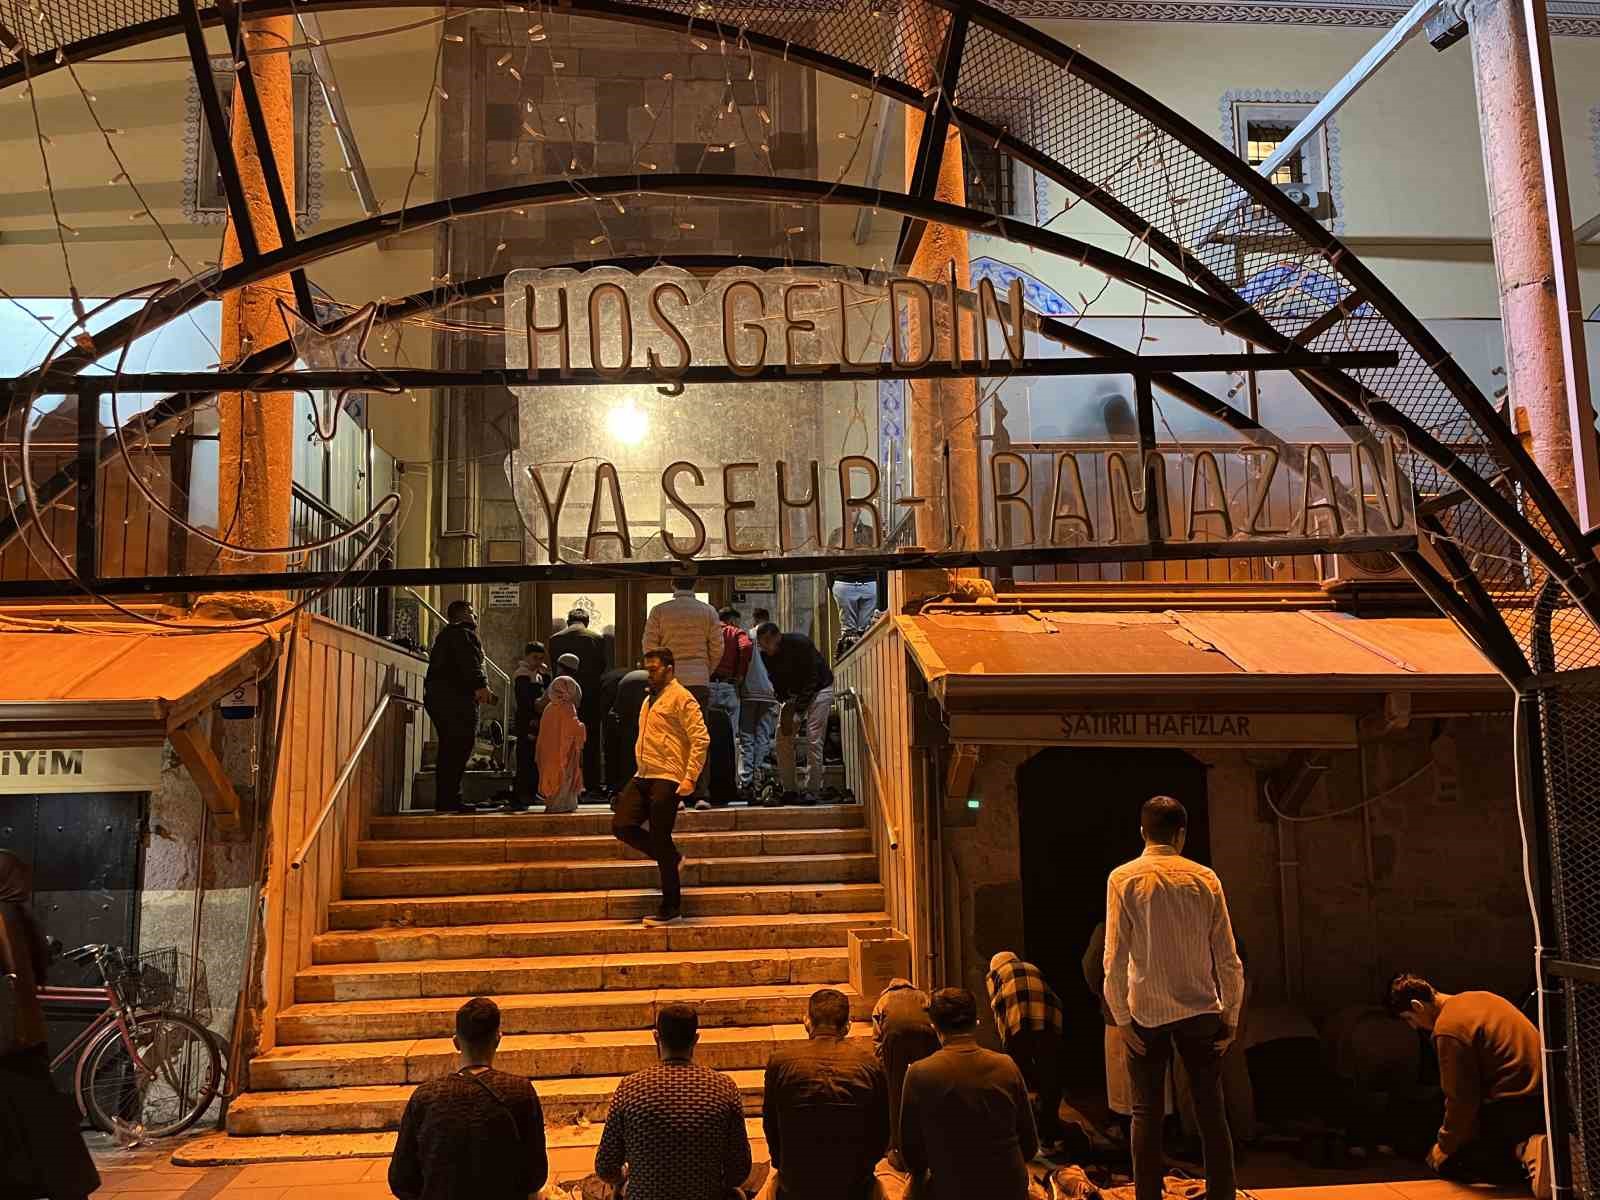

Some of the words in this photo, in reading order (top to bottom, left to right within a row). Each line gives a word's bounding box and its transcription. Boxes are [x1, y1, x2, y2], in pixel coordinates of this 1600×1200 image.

[525, 282, 692, 395] HOŞ
[529, 462, 633, 563] YA
[990, 432, 1406, 550] RAMAZAN
